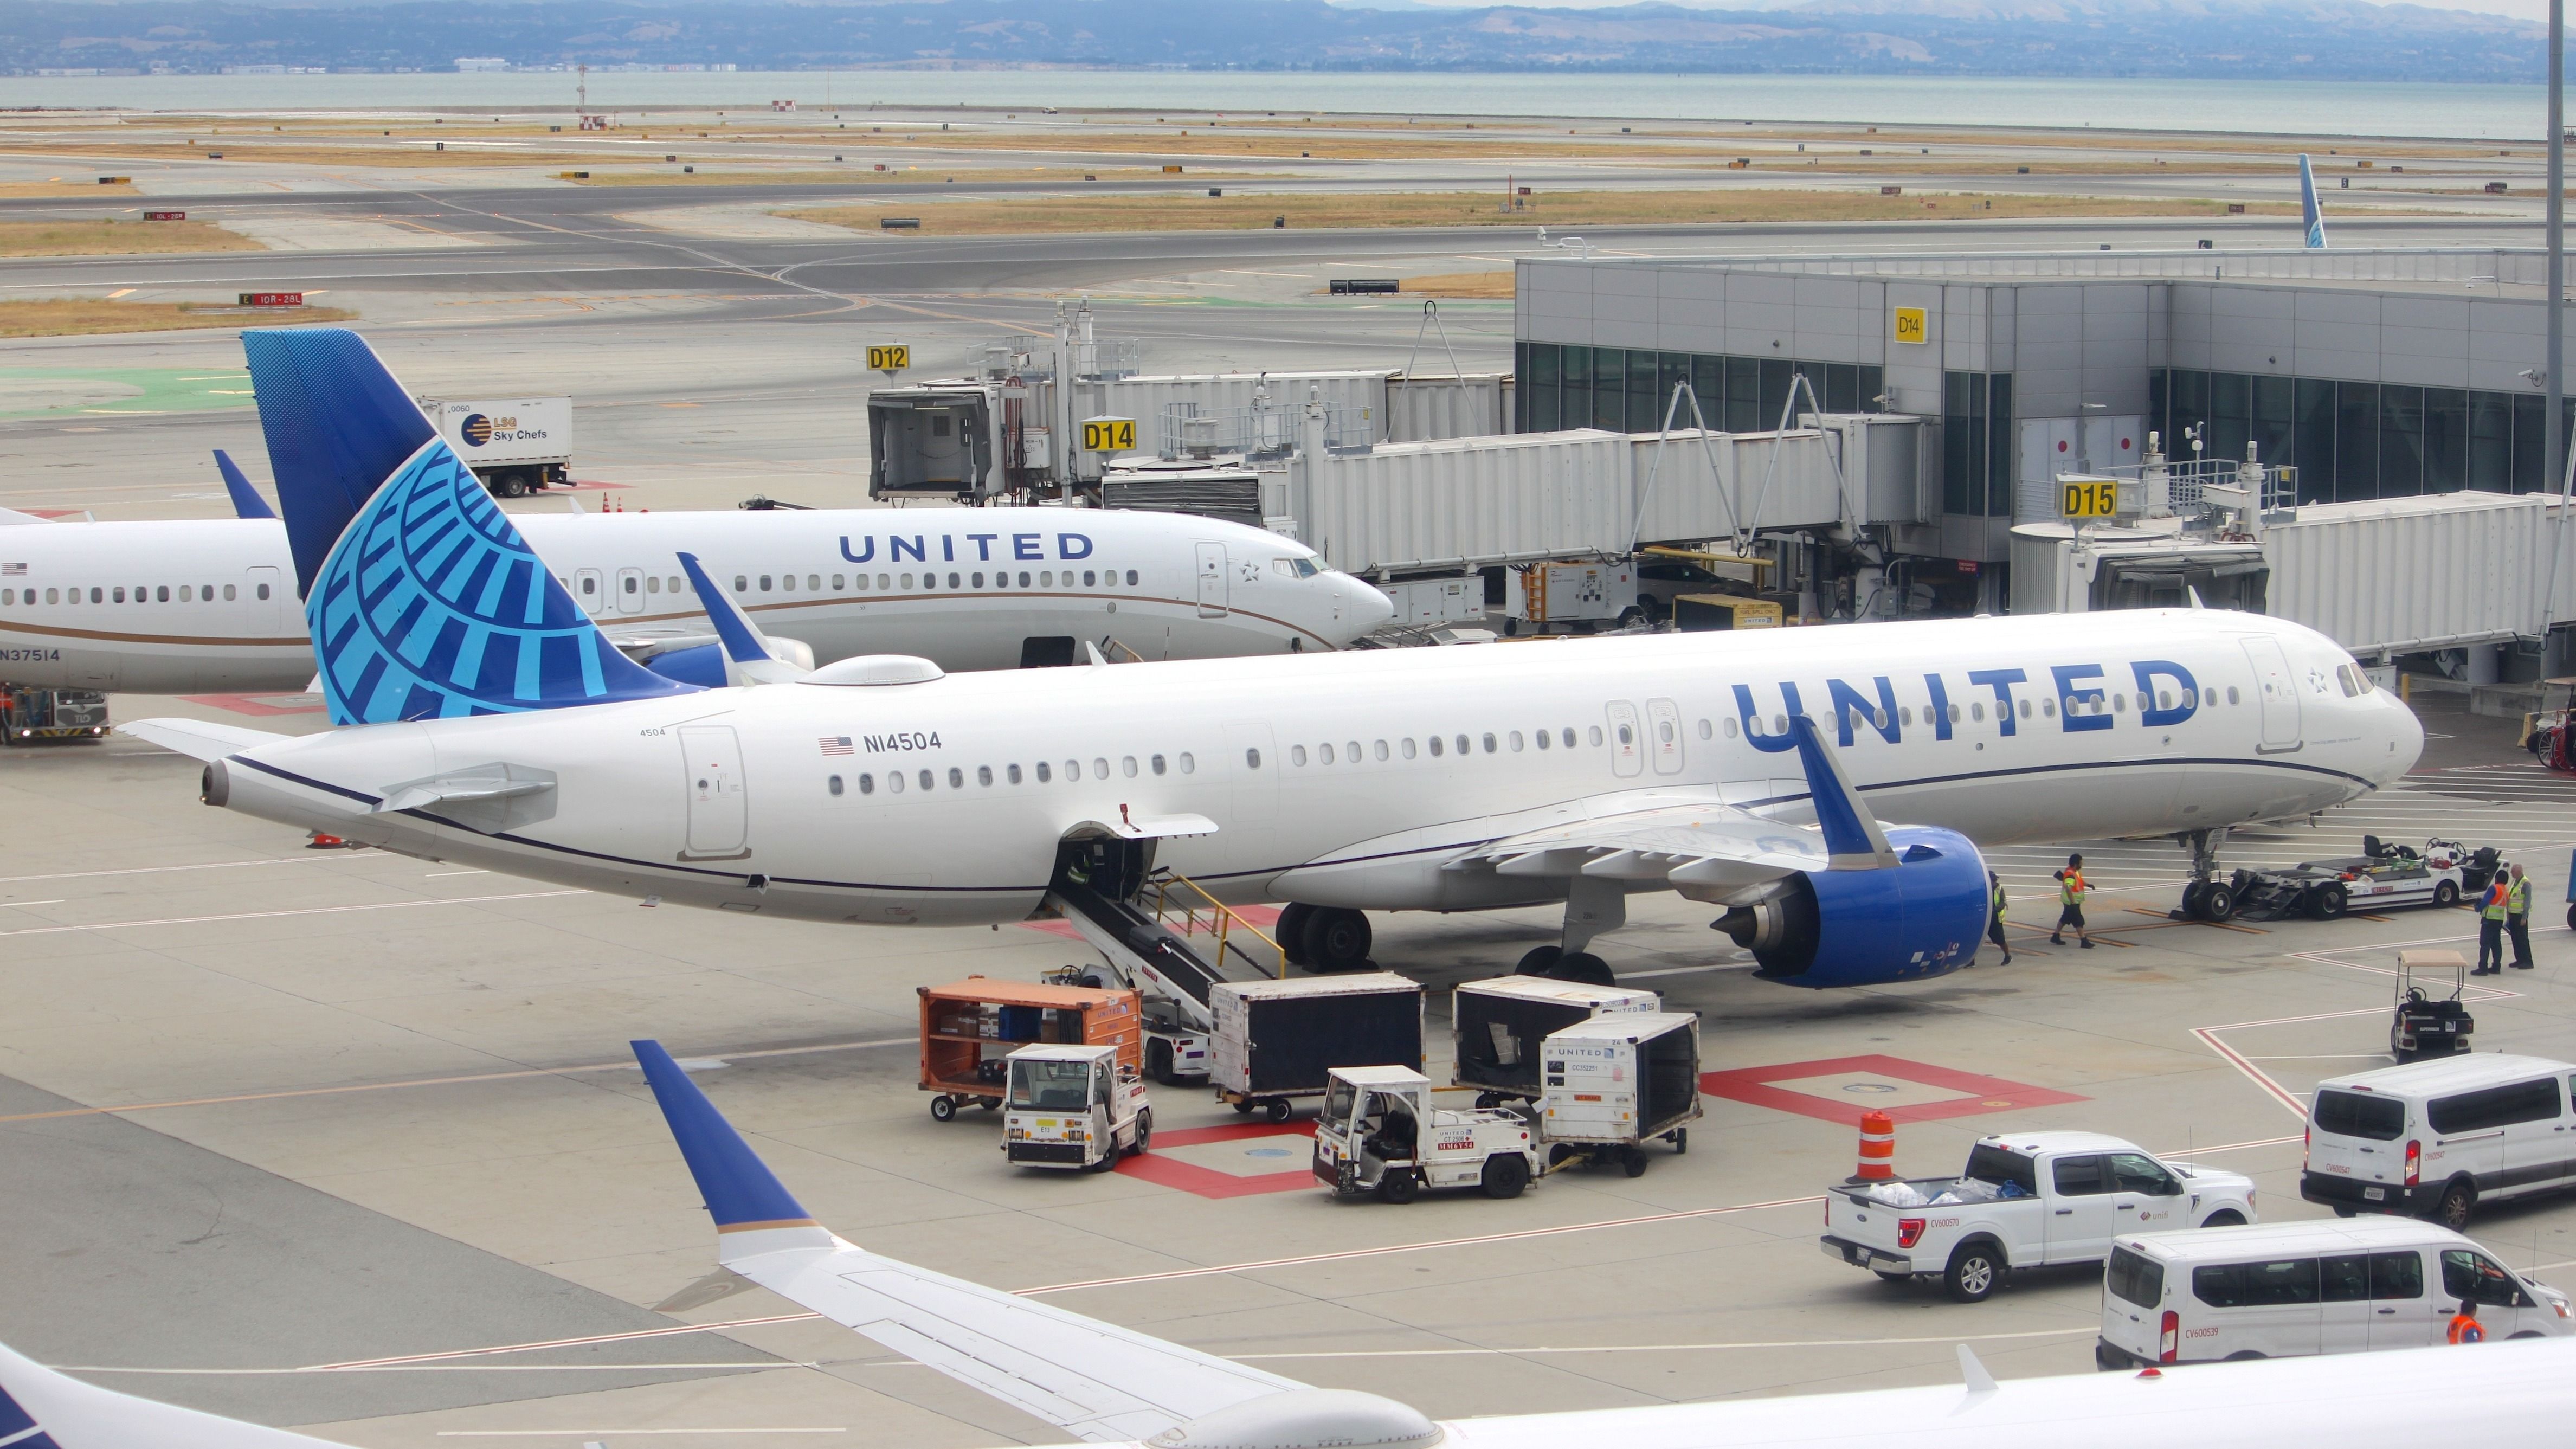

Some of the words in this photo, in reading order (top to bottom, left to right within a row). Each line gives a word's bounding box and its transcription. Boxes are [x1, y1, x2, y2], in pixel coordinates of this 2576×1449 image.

[244, 295, 249, 304] E
[1898, 316, 1920, 334] D14
[871, 347, 906, 369] D12
[494, 417, 517, 427] LSG
[494, 431, 513, 441] Sky
[517, 429, 547, 440] Chefs
[1084, 423, 1134, 450] D14
[2064, 482, 2115, 516] D15
[839, 533, 1094, 563] UNITED
[0, 649, 60, 661] N37514
[1732, 660, 2199, 754] UNITED
[74, 715, 91, 723] TLD
[640, 728, 666, 737] 4504
[864, 731, 942, 754] N14504
[1217, 997, 1233, 1008] UNITED
[1097, 1008, 1120, 1017] UNITED
[2425, 1150, 2445, 1161] CV600547
[2326, 1163, 2350, 1174] CV600547
[1931, 1218, 1960, 1228] CV600570
[2185, 1327, 2219, 1338] CV600539
